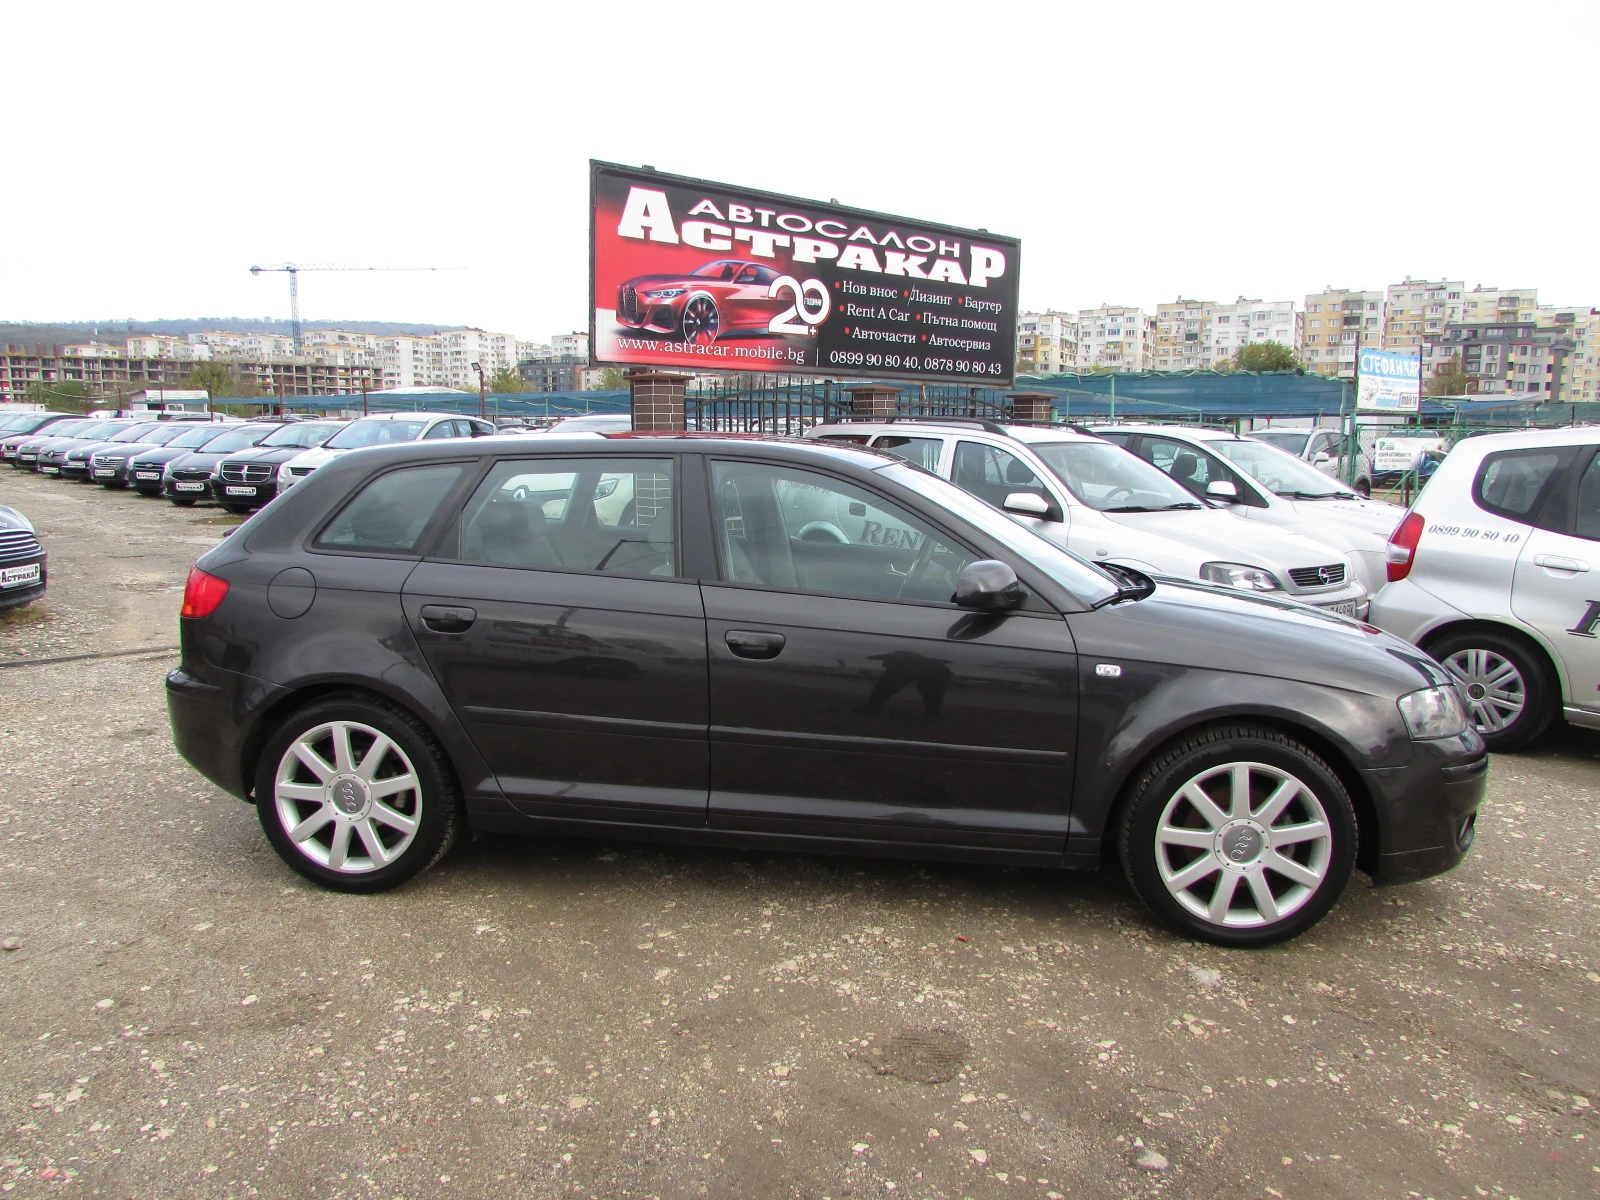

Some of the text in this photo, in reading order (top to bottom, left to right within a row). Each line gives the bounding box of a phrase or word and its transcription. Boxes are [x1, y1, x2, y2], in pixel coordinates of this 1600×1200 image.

[688, 199, 961, 258] АВТОСАЛОН
[843, 280, 1002, 313] Нов внос Лизинг Бартер
[847, 304, 910, 322] Rent A Car
[923, 312, 997, 333] Пътна помощ
[617, 338, 805, 364] www.astracar.mobile.bg
[852, 327, 991, 351] Авточасти Автосервиз
[829, 351, 1002, 375] 0899 90 80 40, 0878 90 80 43
[1428, 524, 1520, 544] 0899 90 80 40
